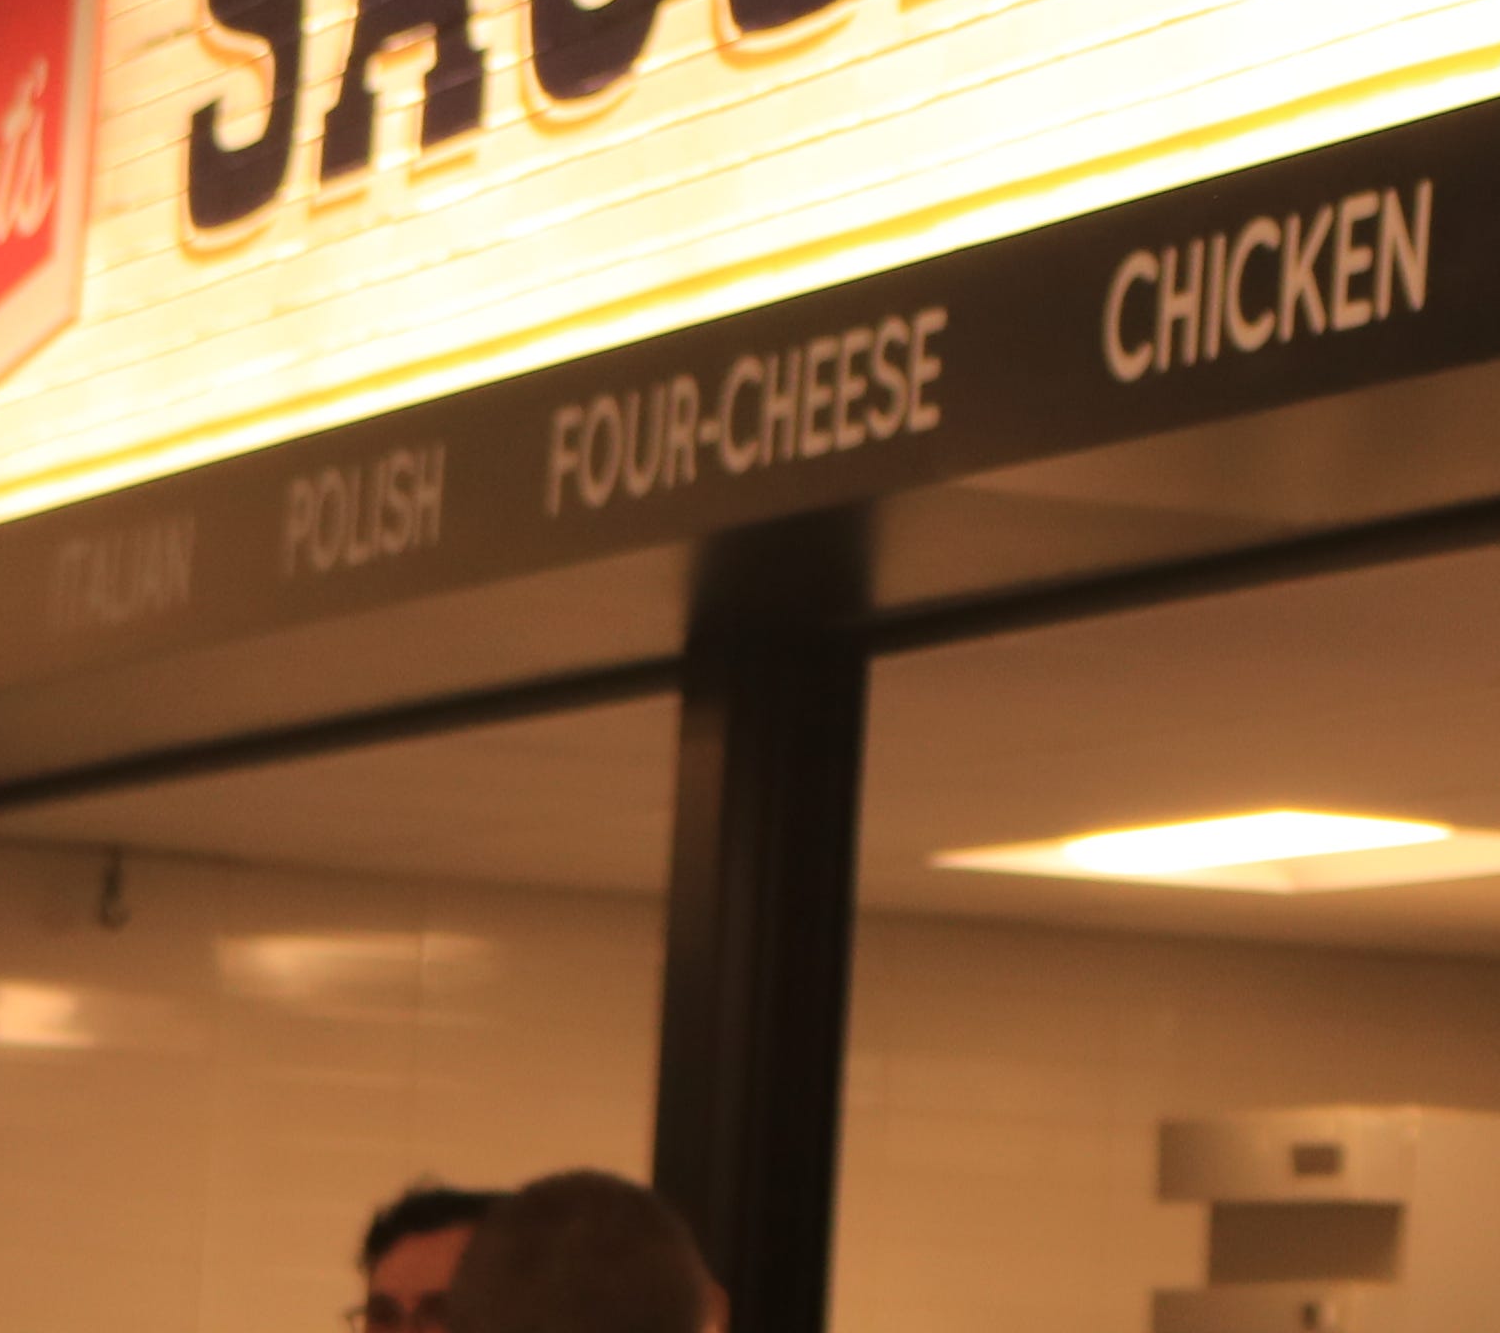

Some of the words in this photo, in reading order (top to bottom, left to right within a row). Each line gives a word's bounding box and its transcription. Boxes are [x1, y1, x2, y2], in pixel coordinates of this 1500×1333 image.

[280, 443, 448, 579] POLISH
[544, 308, 950, 520] FOUR-CHEESE
[1104, 179, 1434, 381] CHICKEN
